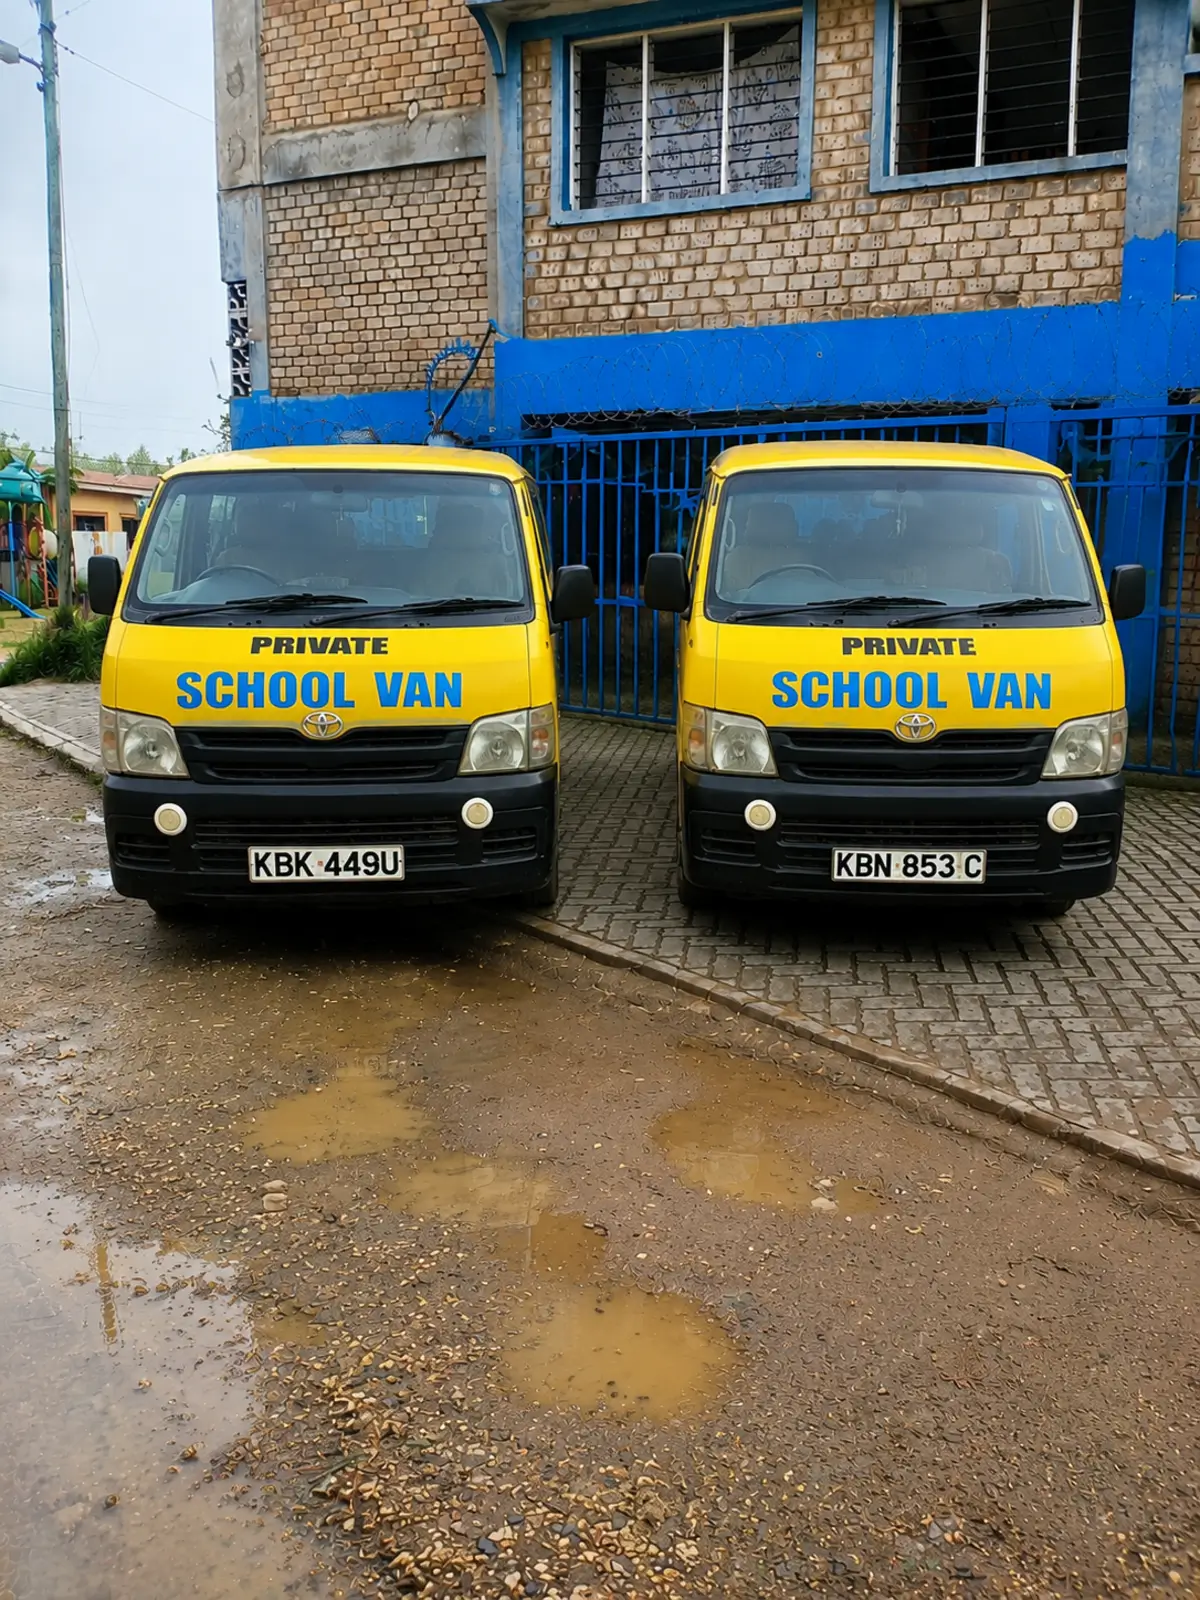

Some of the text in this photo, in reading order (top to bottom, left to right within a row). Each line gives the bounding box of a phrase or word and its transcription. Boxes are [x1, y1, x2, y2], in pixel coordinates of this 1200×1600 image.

[250, 636, 389, 655] PRIVATE
[841, 637, 977, 656] PRIVATE
[176, 670, 462, 709] SCHOOL VAN
[771, 670, 1051, 709] SCHOOL VAN
[254, 850, 399, 877] KBK 449U
[836, 852, 892, 878] KBN
